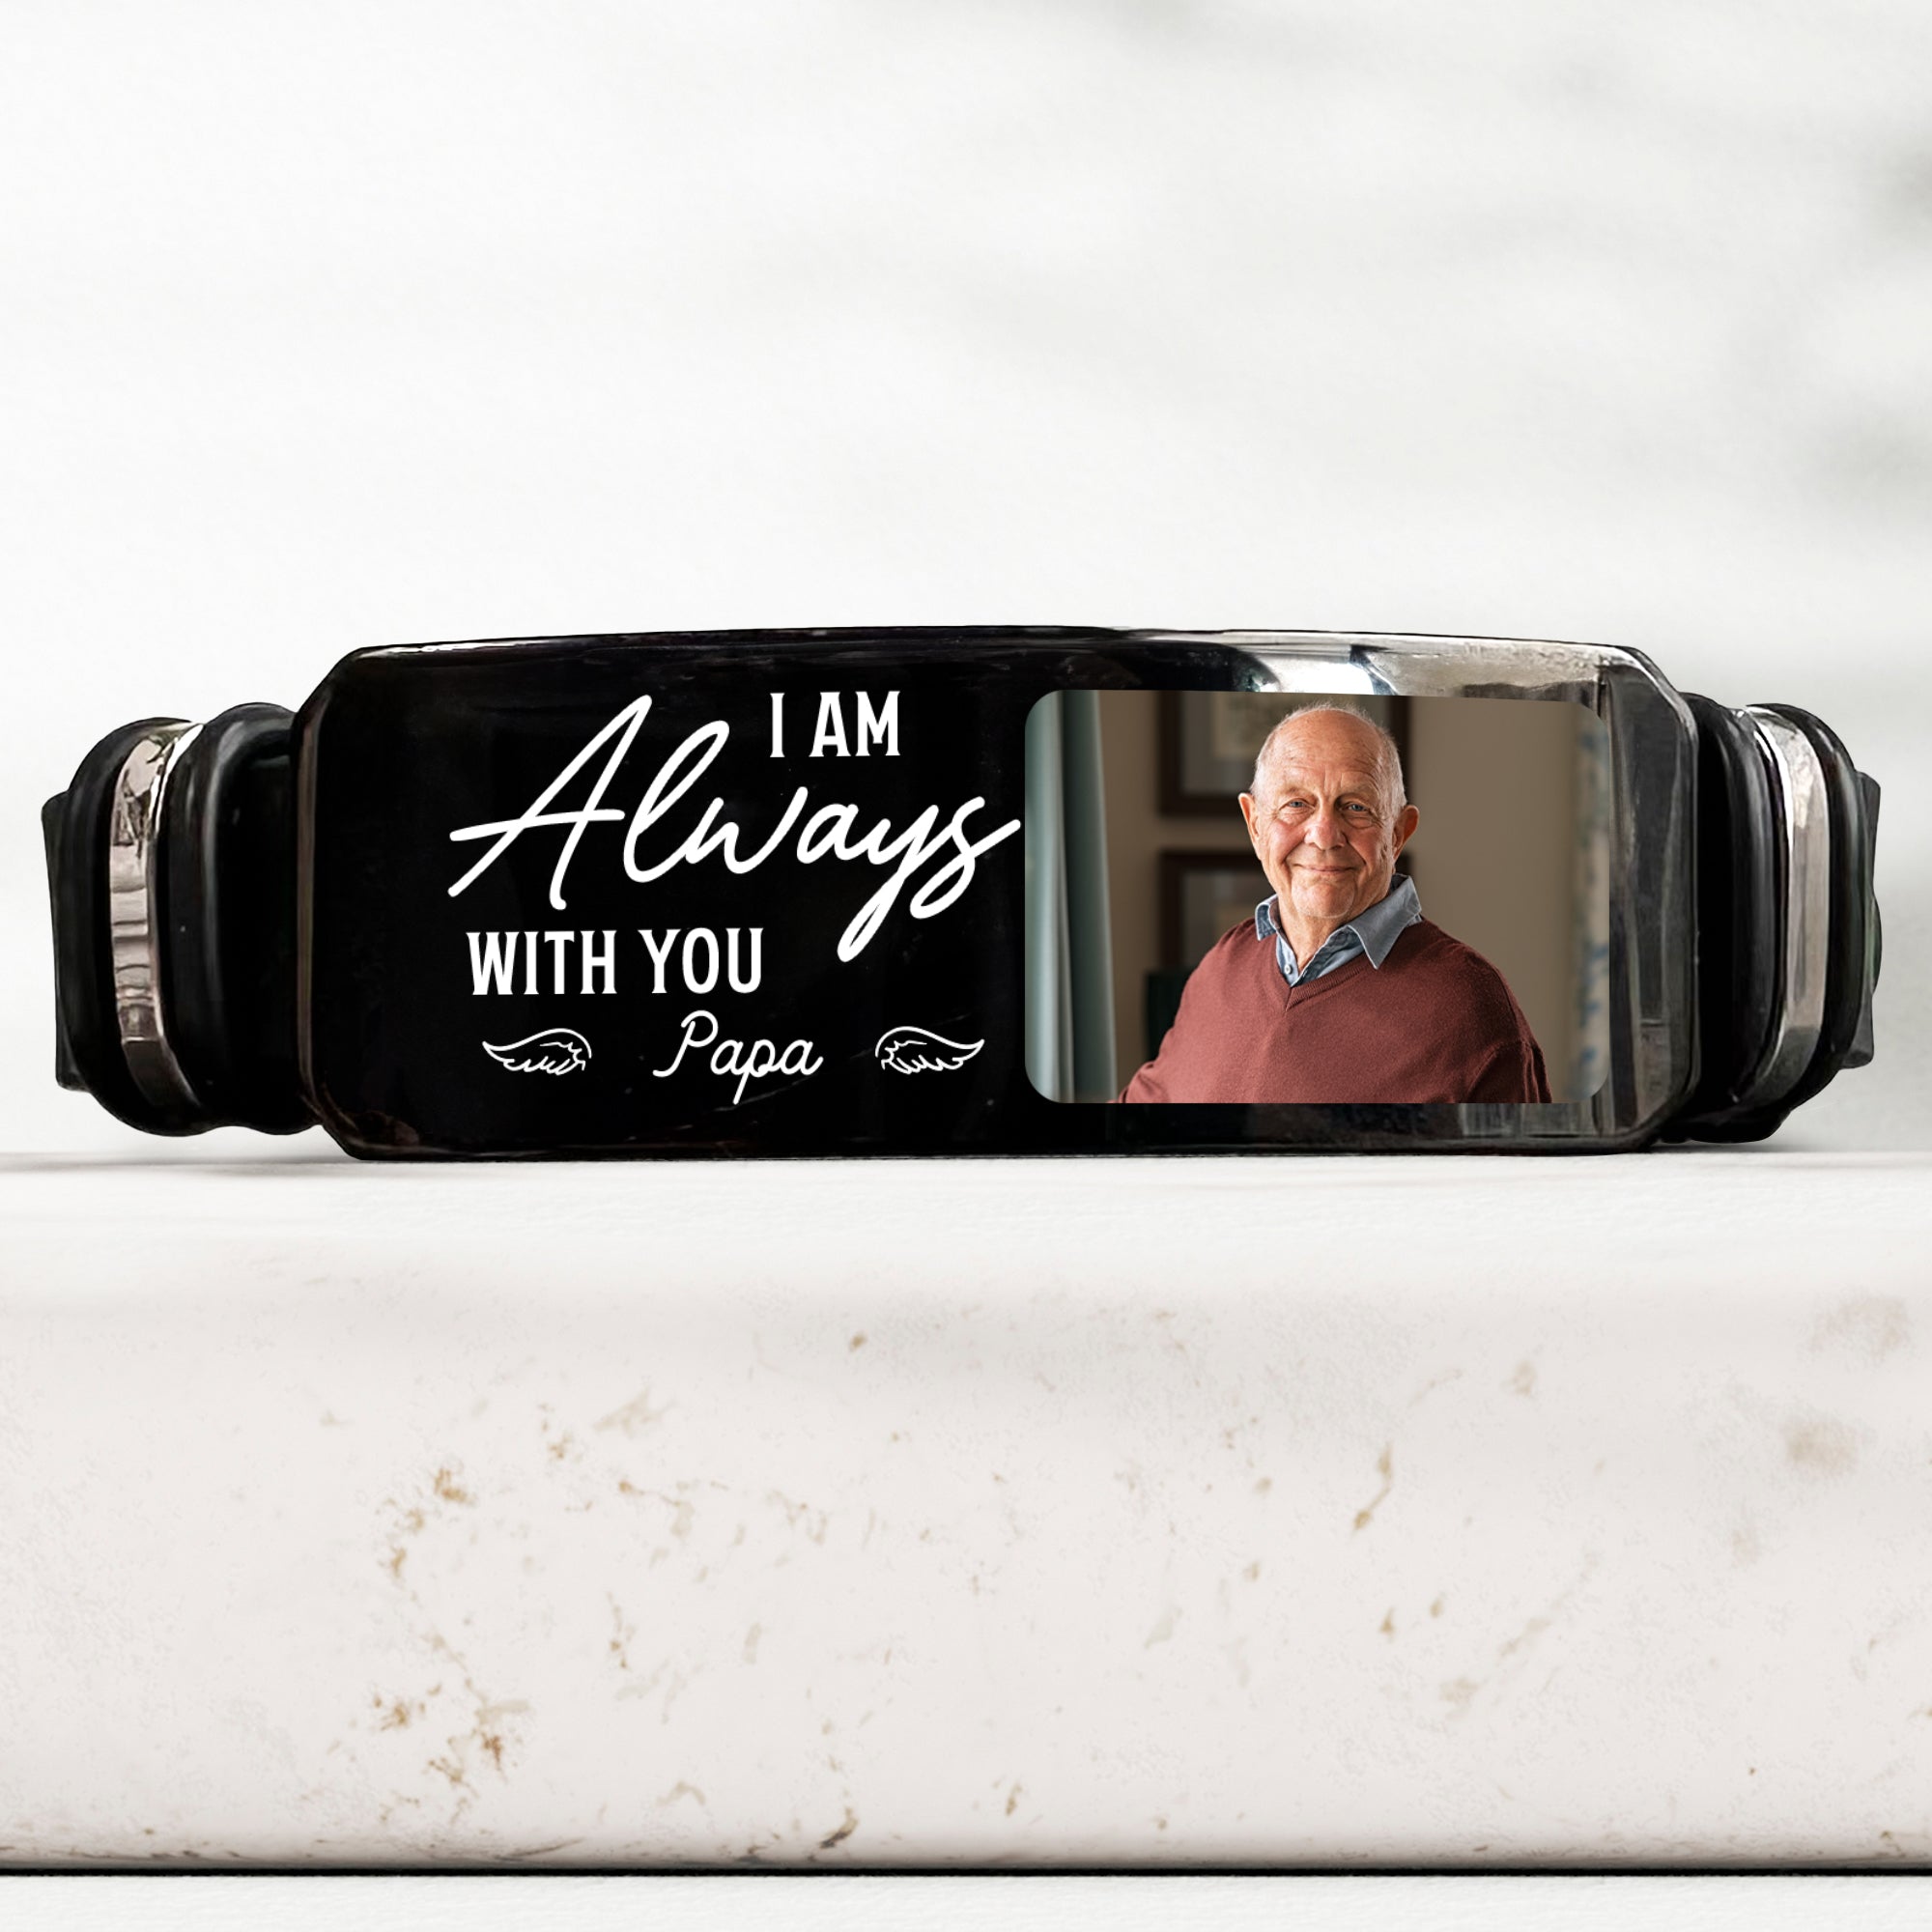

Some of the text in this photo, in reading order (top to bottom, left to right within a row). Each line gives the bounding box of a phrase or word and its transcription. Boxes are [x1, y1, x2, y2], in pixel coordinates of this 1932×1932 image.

[769, 690, 901, 757] I AM
[447, 694, 1022, 963] Always
[466, 926, 764, 996] WITH YOU
[652, 1009, 824, 1105] Papa
